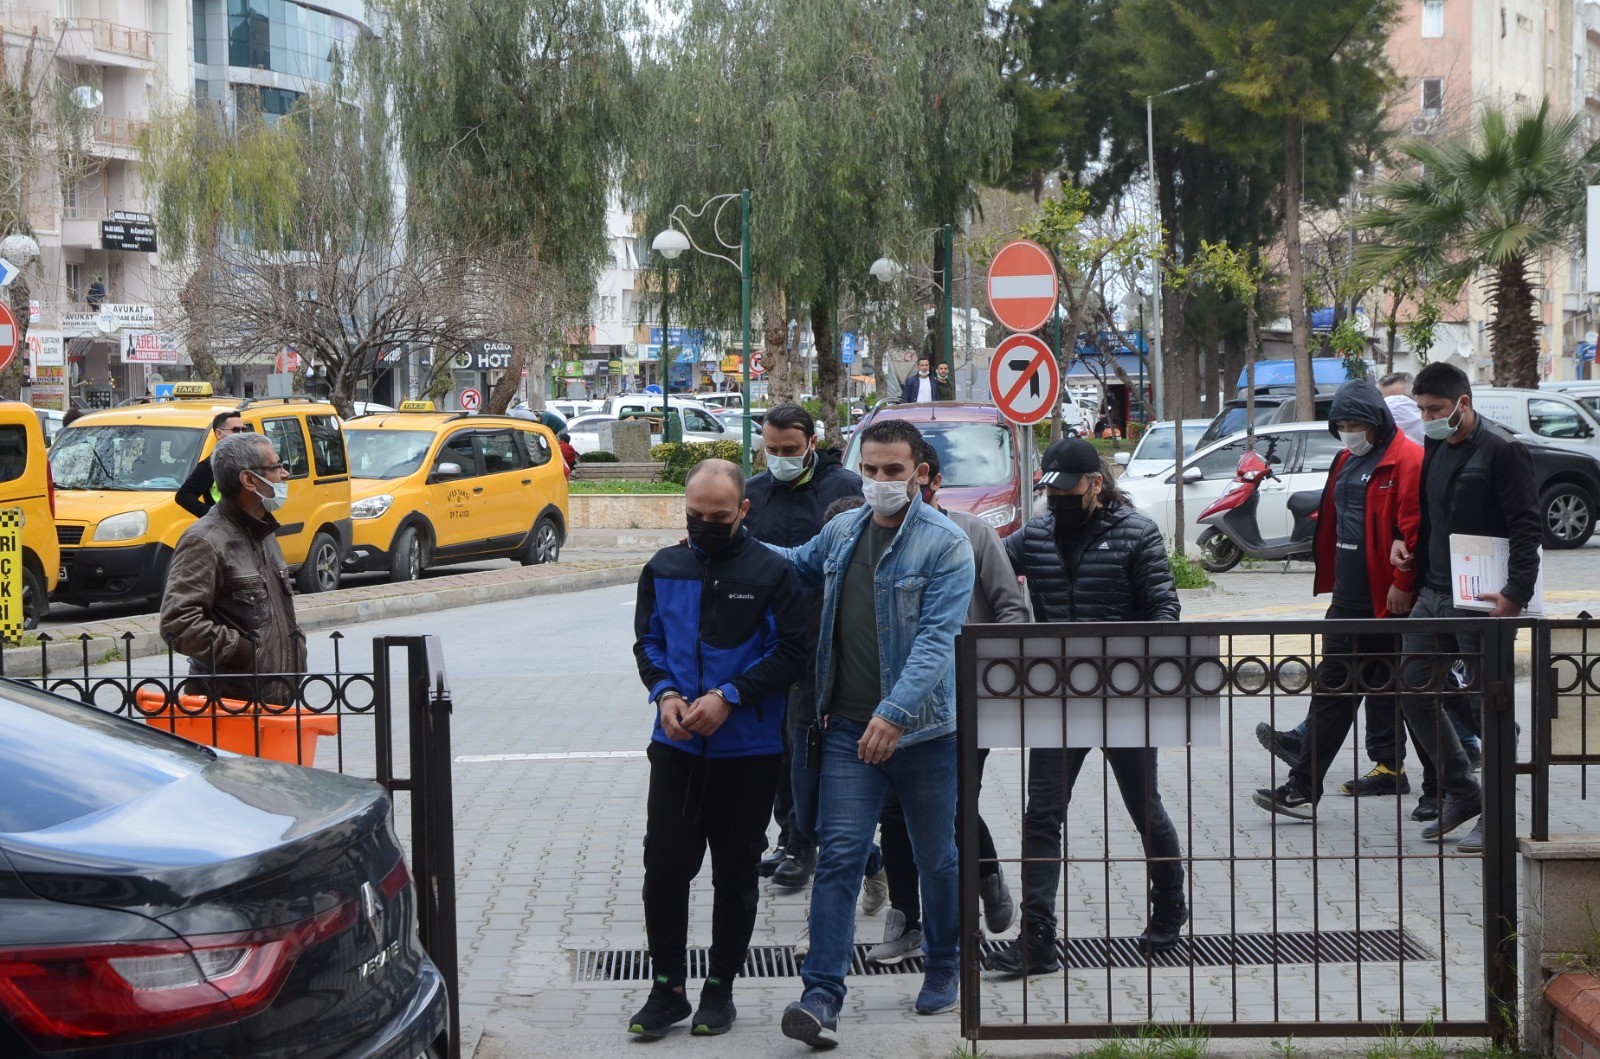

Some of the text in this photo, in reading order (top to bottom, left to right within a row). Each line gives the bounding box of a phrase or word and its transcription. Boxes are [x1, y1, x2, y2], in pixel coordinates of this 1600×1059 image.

[113, 305, 145, 313] AVUKAT
[136, 335, 160, 349] ADELL
[478, 353, 512, 367] HOT
